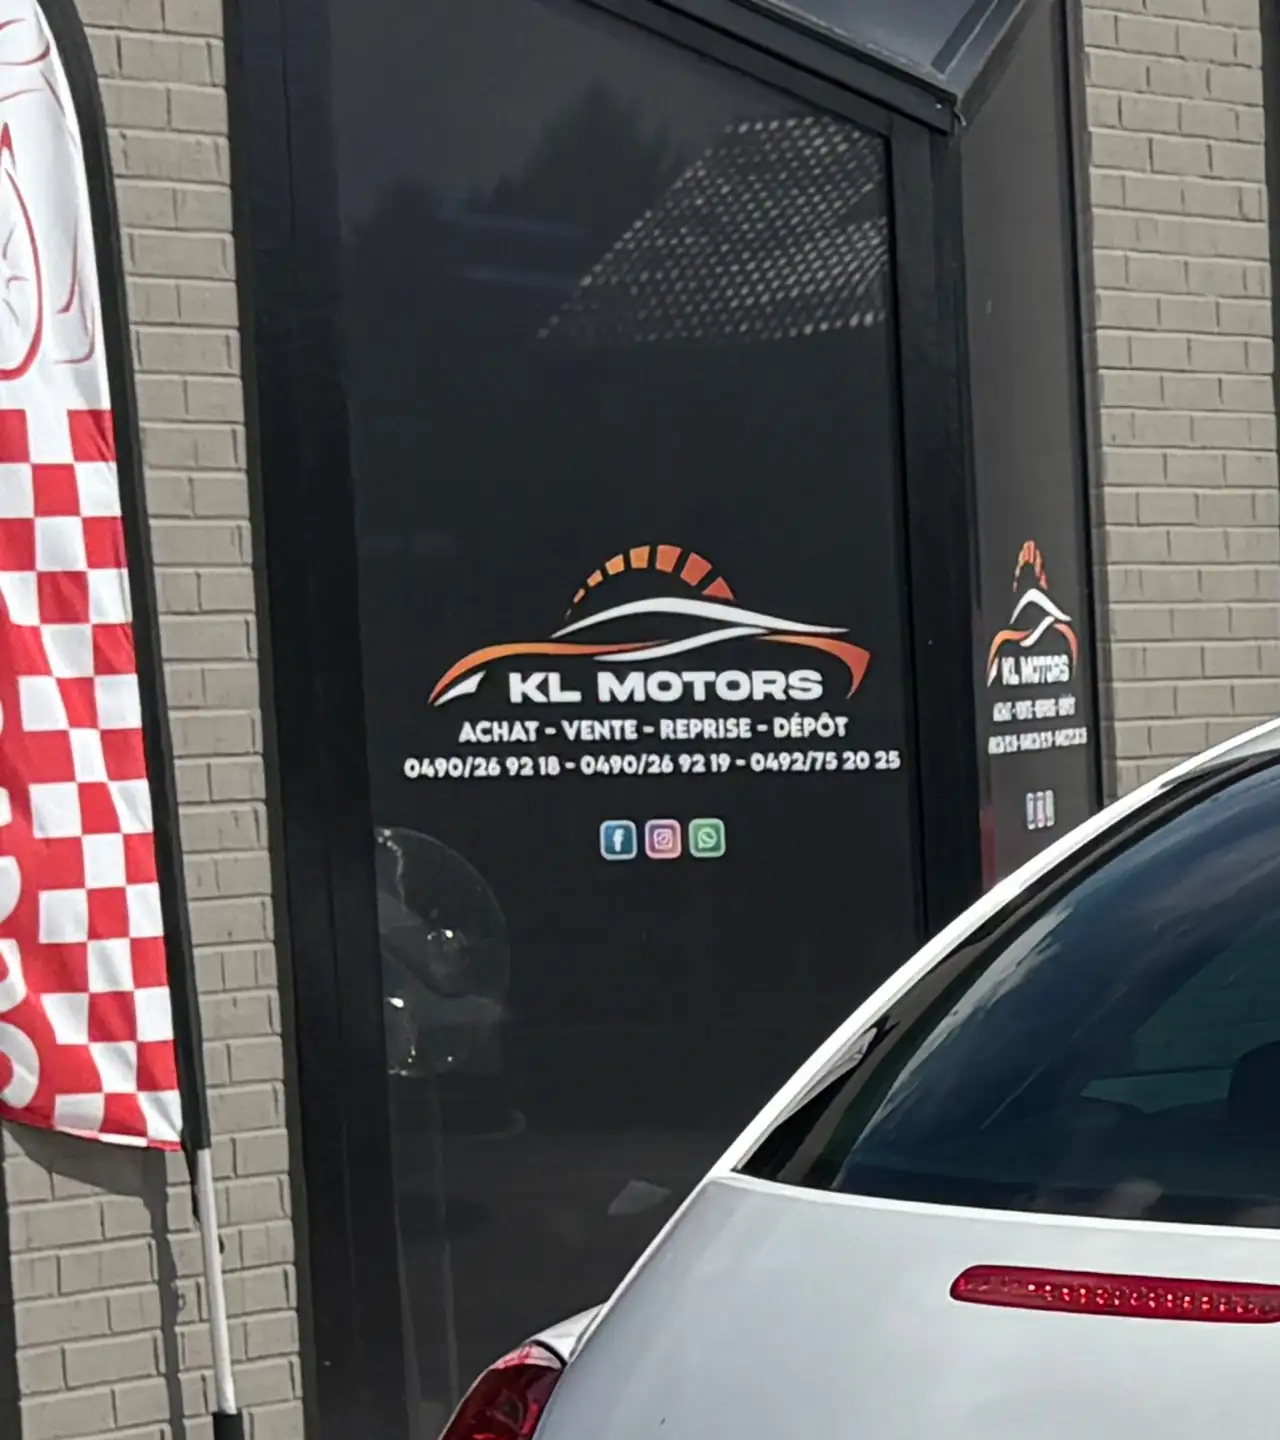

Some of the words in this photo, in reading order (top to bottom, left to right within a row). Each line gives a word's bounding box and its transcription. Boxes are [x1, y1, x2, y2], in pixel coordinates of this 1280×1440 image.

[508, 671, 582, 704] KL
[596, 669, 824, 703] MOTORS
[458, 719, 540, 744] ACHAT
[561, 718, 638, 742] VENTE
[659, 716, 752, 741] REPRISE
[773, 711, 849, 739] DÉPÔT
[403, 755, 501, 779] 0490/26
[505, 756, 534, 778] 92
[580, 753, 674, 775] 0490/26
[678, 753, 706, 774] 92
[710, 752, 731, 773] 19
[750, 750, 839, 772] 0492/75
[842, 751, 870, 771] 20
[874, 750, 901, 770] 25
